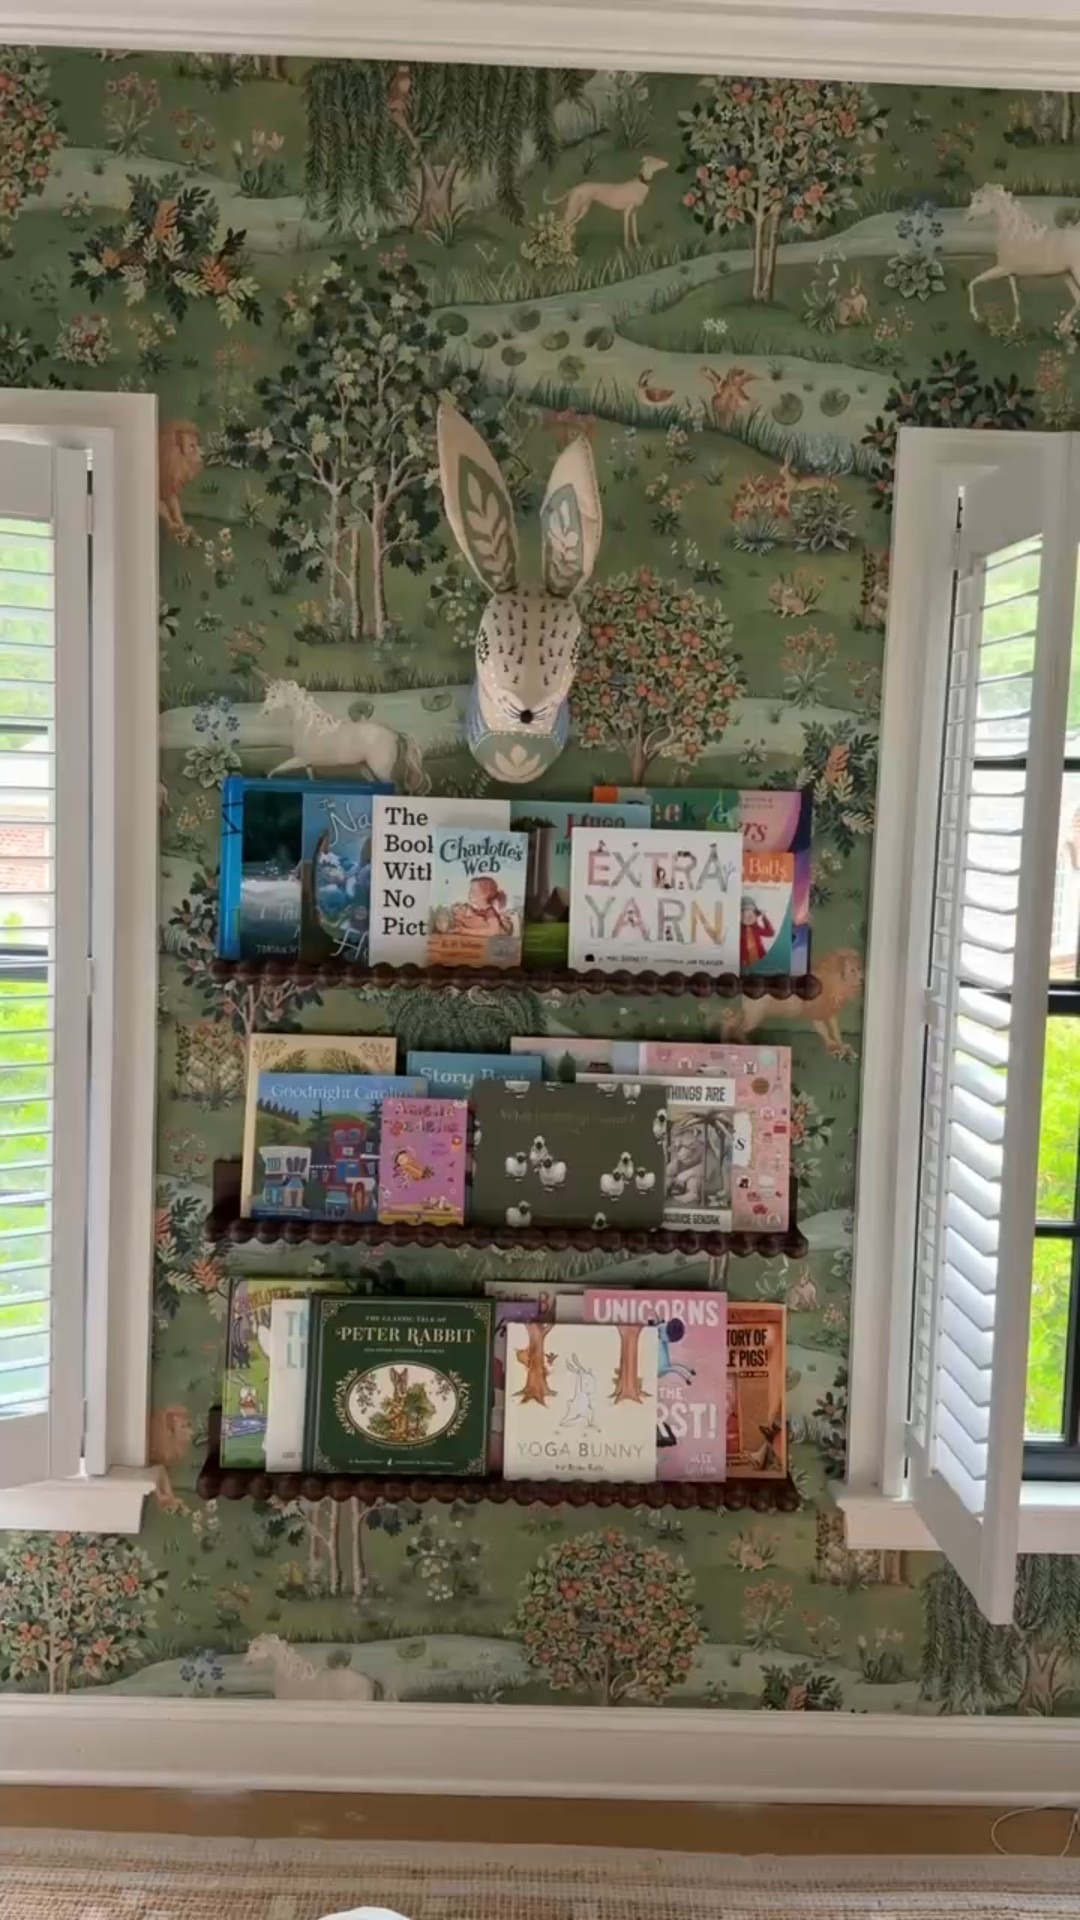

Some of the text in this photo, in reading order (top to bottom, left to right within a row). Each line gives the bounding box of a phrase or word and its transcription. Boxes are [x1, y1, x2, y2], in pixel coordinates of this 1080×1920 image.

[385, 807, 428, 827] The
[737, 821, 768, 843] rs
[439, 835, 523, 863] Charlotte's
[462, 857, 501, 876] Web
[587, 842, 728, 893] EXTRA
[382, 890, 415, 908] No
[382, 917, 427, 936] Pict
[584, 894, 726, 946] YARN
[420, 1067, 475, 1089] Story
[271, 1083, 351, 1101] Goodnight
[705, 1087, 726, 1102] ARE
[593, 1298, 720, 1327] UNICORNS
[341, 1327, 475, 1346] PETER RABBIT
[754, 1329, 768, 1346] OF
[739, 1350, 769, 1367] PIGS!
[659, 1387, 683, 1400] THE
[517, 1441, 644, 1458] YOGA BUNNY
